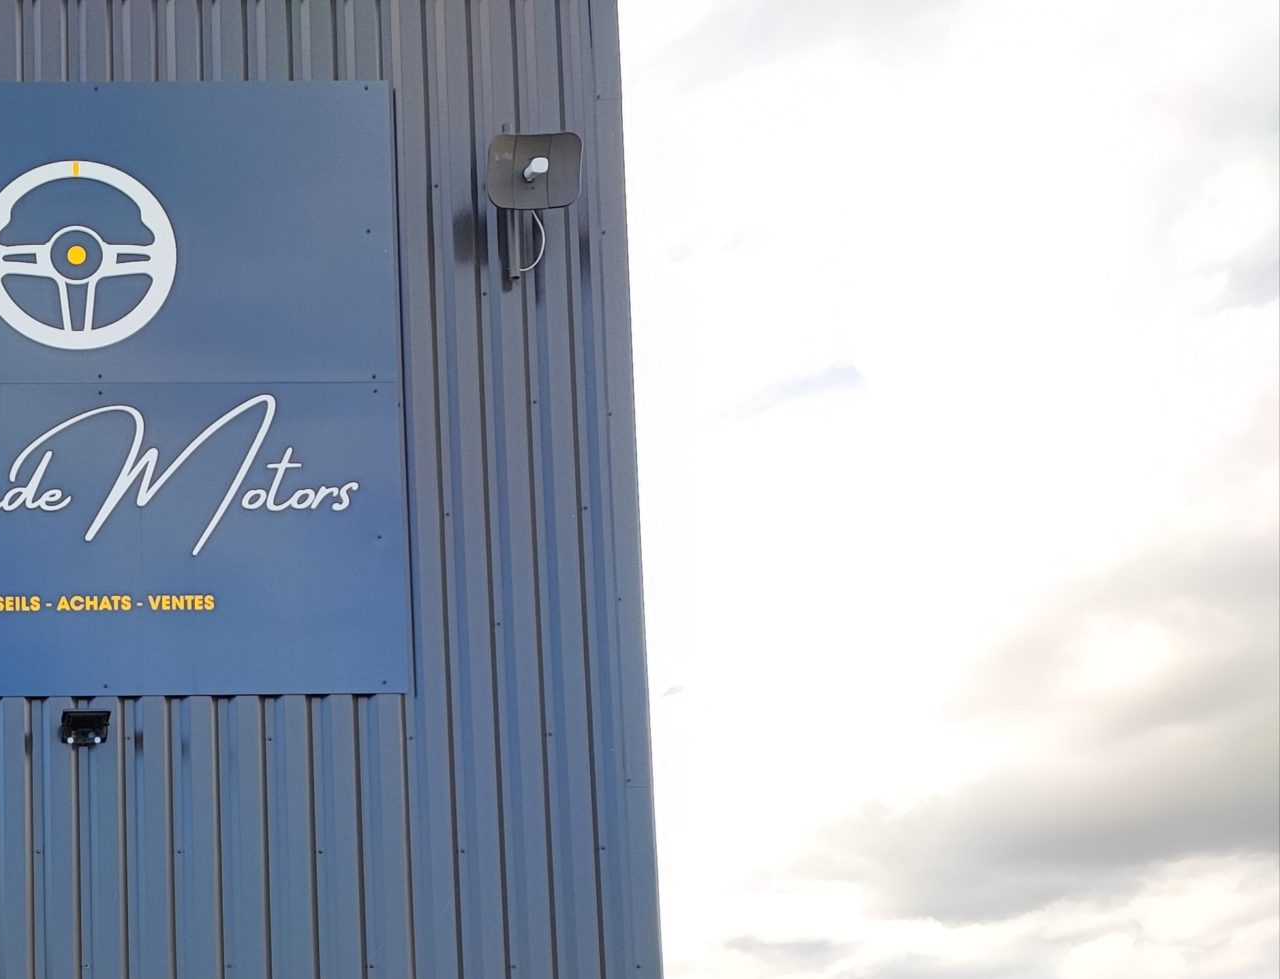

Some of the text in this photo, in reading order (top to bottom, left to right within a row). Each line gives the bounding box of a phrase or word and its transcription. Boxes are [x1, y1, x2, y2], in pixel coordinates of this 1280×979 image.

[10, 394, 359, 556] Motors
[56, 594, 132, 610] ACHATS
[148, 594, 215, 610] VENTES
